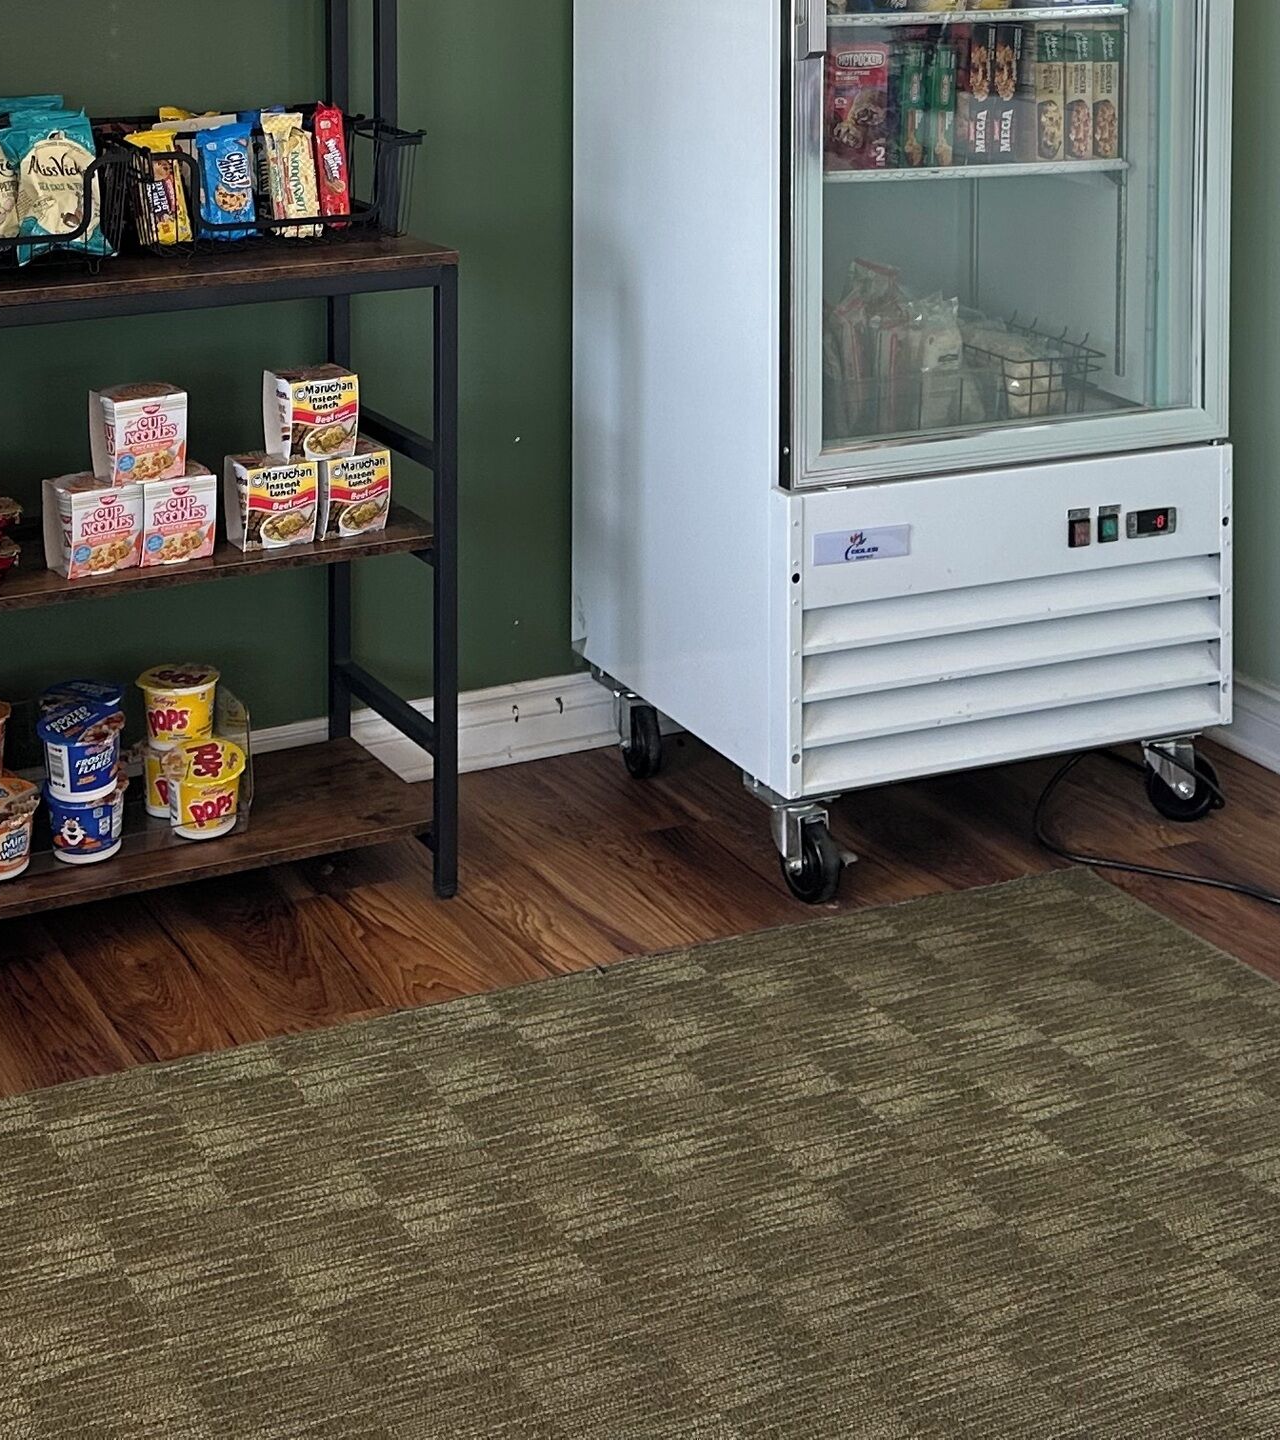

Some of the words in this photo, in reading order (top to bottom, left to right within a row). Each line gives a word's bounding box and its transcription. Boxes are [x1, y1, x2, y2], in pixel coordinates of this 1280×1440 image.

[975, 111, 988, 153] MEGA
[1000, 109, 1014, 153] MEGA
[27, 157, 56, 176] Miss
[219, 160, 251, 186] Ahoy!
[225, 152, 248, 179] Chips
[305, 382, 353, 395] Maruchan
[308, 393, 342, 403] Instant
[312, 402, 339, 411] Lunch
[137, 414, 167, 432] CUP
[315, 413, 334, 424] Beef
[124, 424, 177, 445] NOODLES
[341, 457, 386, 472] Maruchan
[262, 468, 312, 482] Maruchan
[345, 469, 375, 480] Instant
[266, 480, 300, 491] Instant
[348, 479, 372, 488] Lunch
[270, 488, 297, 497] Lunch
[351, 489, 368, 500] Beef
[166, 495, 196, 512] CUP
[272, 500, 292, 510] Beef
[94, 504, 124, 521] CUP
[153, 504, 207, 526] NOODLES
[81, 514, 134, 537] NOODLES
[55, 712, 91, 733] FLAKES
[148, 710, 189, 738] POPS
[78, 757, 111, 775] FLAKES
[189, 792, 234, 828] POPS
[2, 835, 27, 851] Mini
